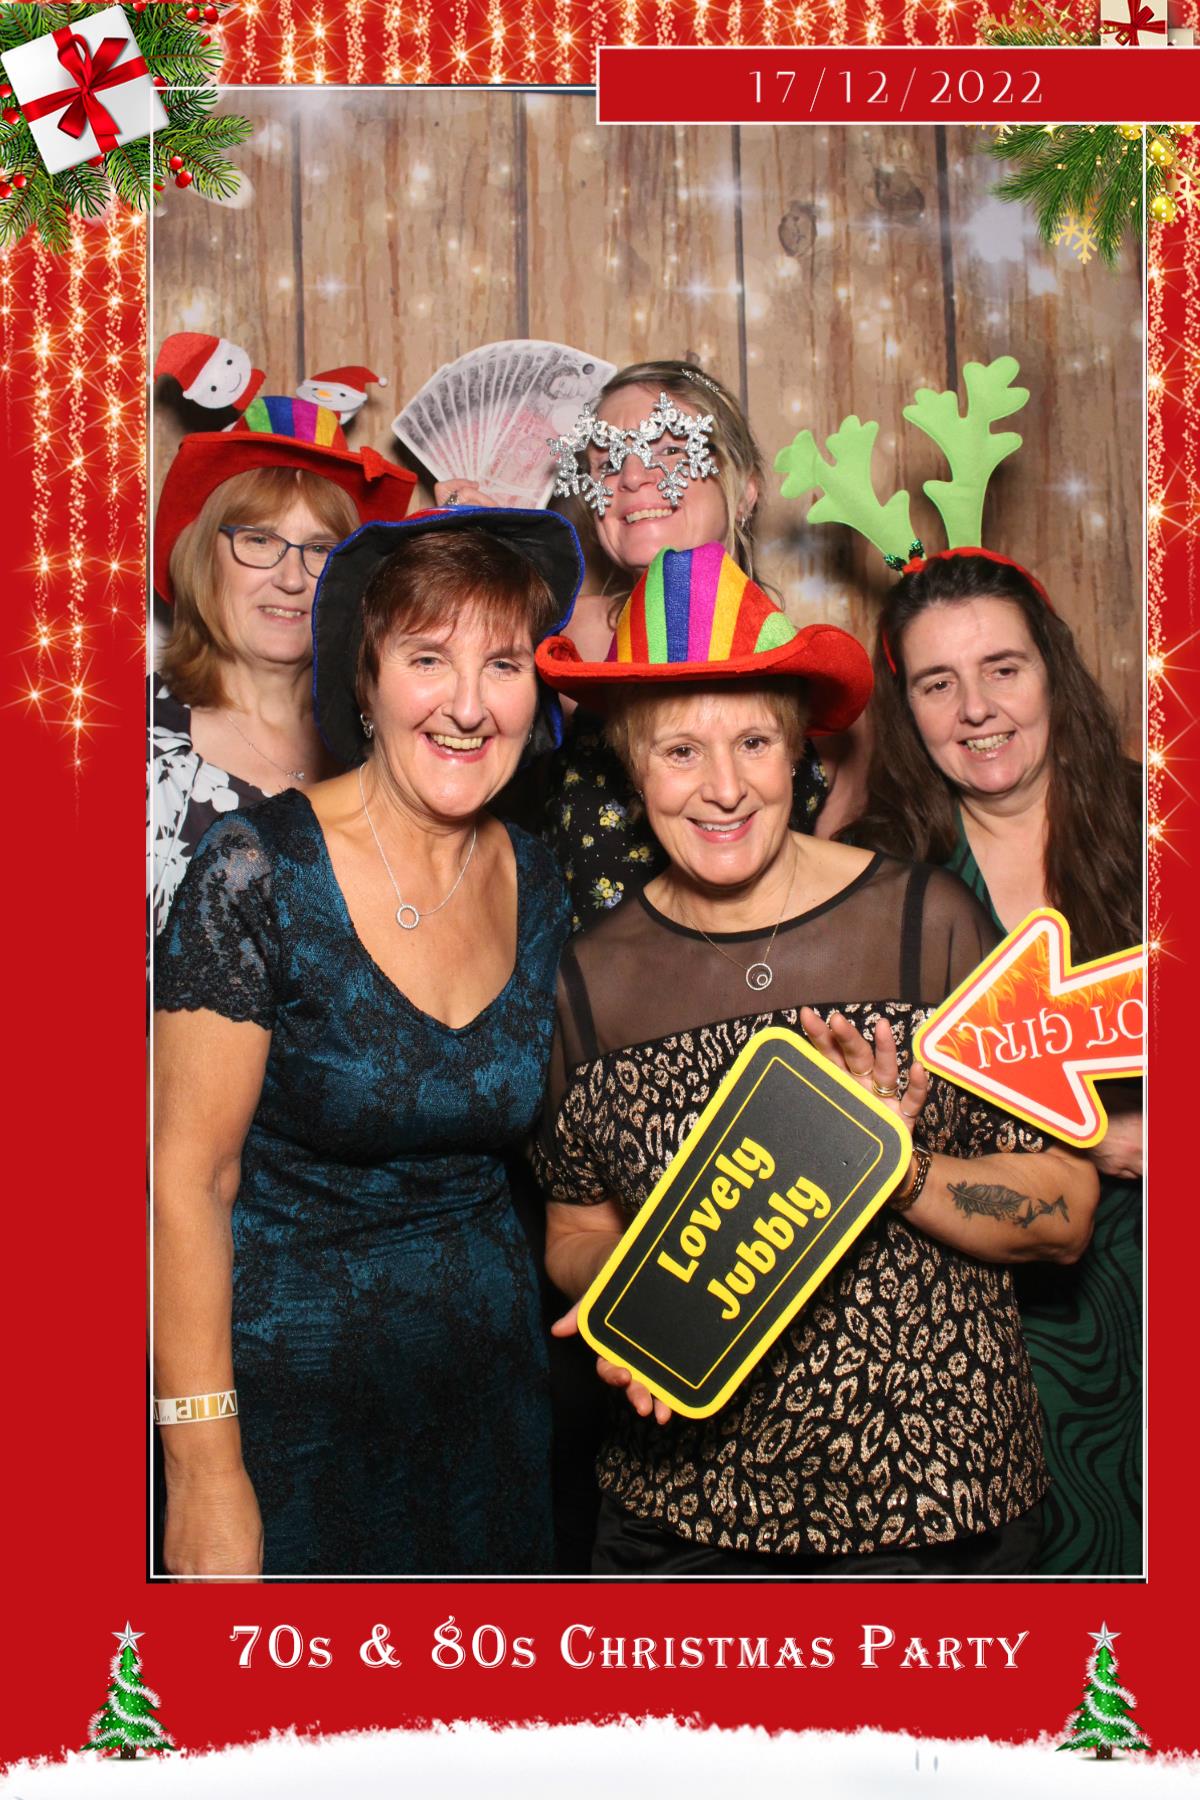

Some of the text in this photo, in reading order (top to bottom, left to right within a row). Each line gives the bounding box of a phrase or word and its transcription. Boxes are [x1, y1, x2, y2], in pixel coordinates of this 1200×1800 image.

[958, 1008, 1072, 1069] GIRL
[656, 1136, 775, 1283] Lovely
[707, 1176, 831, 1320] Jubbly
